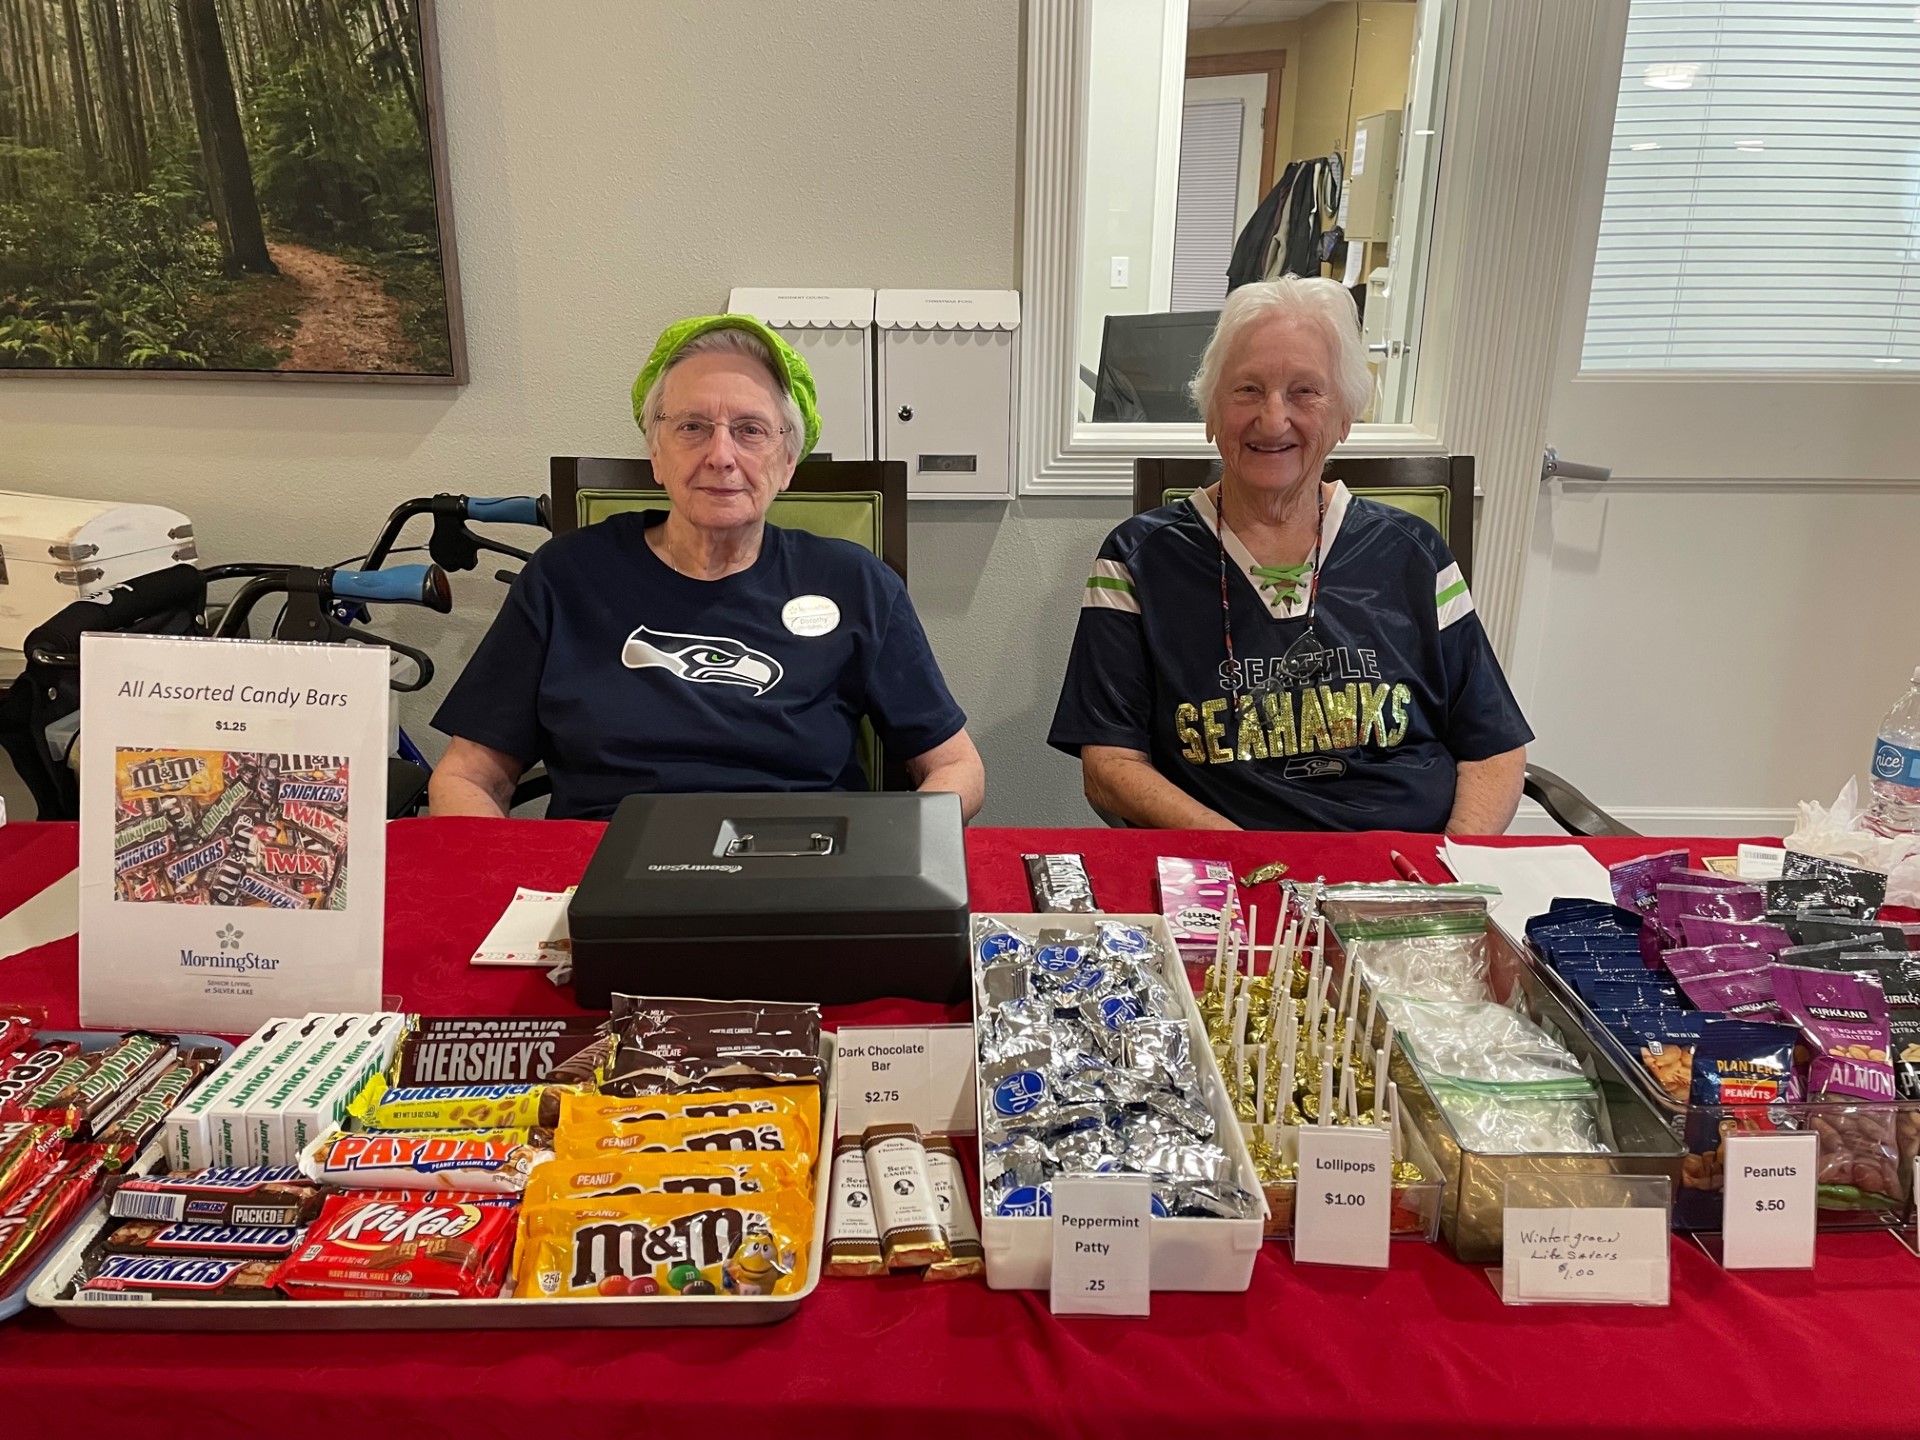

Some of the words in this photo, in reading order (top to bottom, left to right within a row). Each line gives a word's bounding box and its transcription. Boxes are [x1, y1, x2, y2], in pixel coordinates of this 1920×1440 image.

[1218, 646, 1381, 691] SEATTLE
[118, 680, 145, 699] All
[148, 682, 234, 702] Assorted
[240, 685, 300, 709] Candy
[306, 687, 348, 708] Bars
[215, 719, 248, 733] $1.25
[1174, 682, 1412, 765] SEAHAWKS
[1876, 754, 1906, 769] nice!
[279, 783, 344, 802] SNICKERS
[167, 841, 225, 882] SNICKERS
[647, 863, 731, 873] SentrySafe
[180, 949, 280, 973] MorningStar
[1809, 1006, 1868, 1019] KIRKLAND
[838, 1046, 864, 1058] Dark
[867, 1043, 925, 1056] Chocolate
[414, 1040, 557, 1083] HERSHEY'S
[871, 1060, 892, 1072] Bar
[184, 1071, 237, 1115] Junior
[231, 1045, 264, 1074] Mints
[228, 1064, 276, 1109] Junior
[272, 1040, 303, 1066] Mints
[264, 1065, 313, 1109] Junior
[305, 1040, 338, 1066] Mints
[302, 1064, 348, 1108] Junior
[342, 1039, 372, 1066] Mints
[379, 1084, 538, 1106] Butterfinger
[864, 1089, 900, 1104] $2.75
[1001, 1075, 1044, 1113] York
[1724, 1088, 1771, 1099] PEANUTS
[178, 1125, 190, 1160] Junior
[221, 1118, 233, 1154] Junior
[259, 1119, 270, 1156] Junior
[602, 1135, 639, 1148] PEANUT
[327, 1137, 520, 1170] PAYDAY
[431, 1161, 456, 1170] PEANUT
[1315, 1157, 1376, 1175] Lollipops
[1743, 1165, 1797, 1179] Peanuts
[576, 1172, 616, 1186] PEANUT
[188, 1202, 227, 1212] SNICKERS
[1324, 1192, 1366, 1208] $1.00
[1755, 1198, 1786, 1212] $.50
[235, 1208, 277, 1224] PACKED
[1061, 1214, 1140, 1230] Peppermint
[162, 1222, 297, 1245] SATISFIES
[1075, 1240, 1110, 1256] Patty
[100, 1256, 239, 1284] SNICKERS
[328, 1269, 344, 1278] HAVE
[369, 1272, 385, 1280] HAVE
[543, 1273, 560, 1284] 250
[1558, 1262, 1596, 1281] $1.00
[1085, 1279, 1106, 1292] .25
